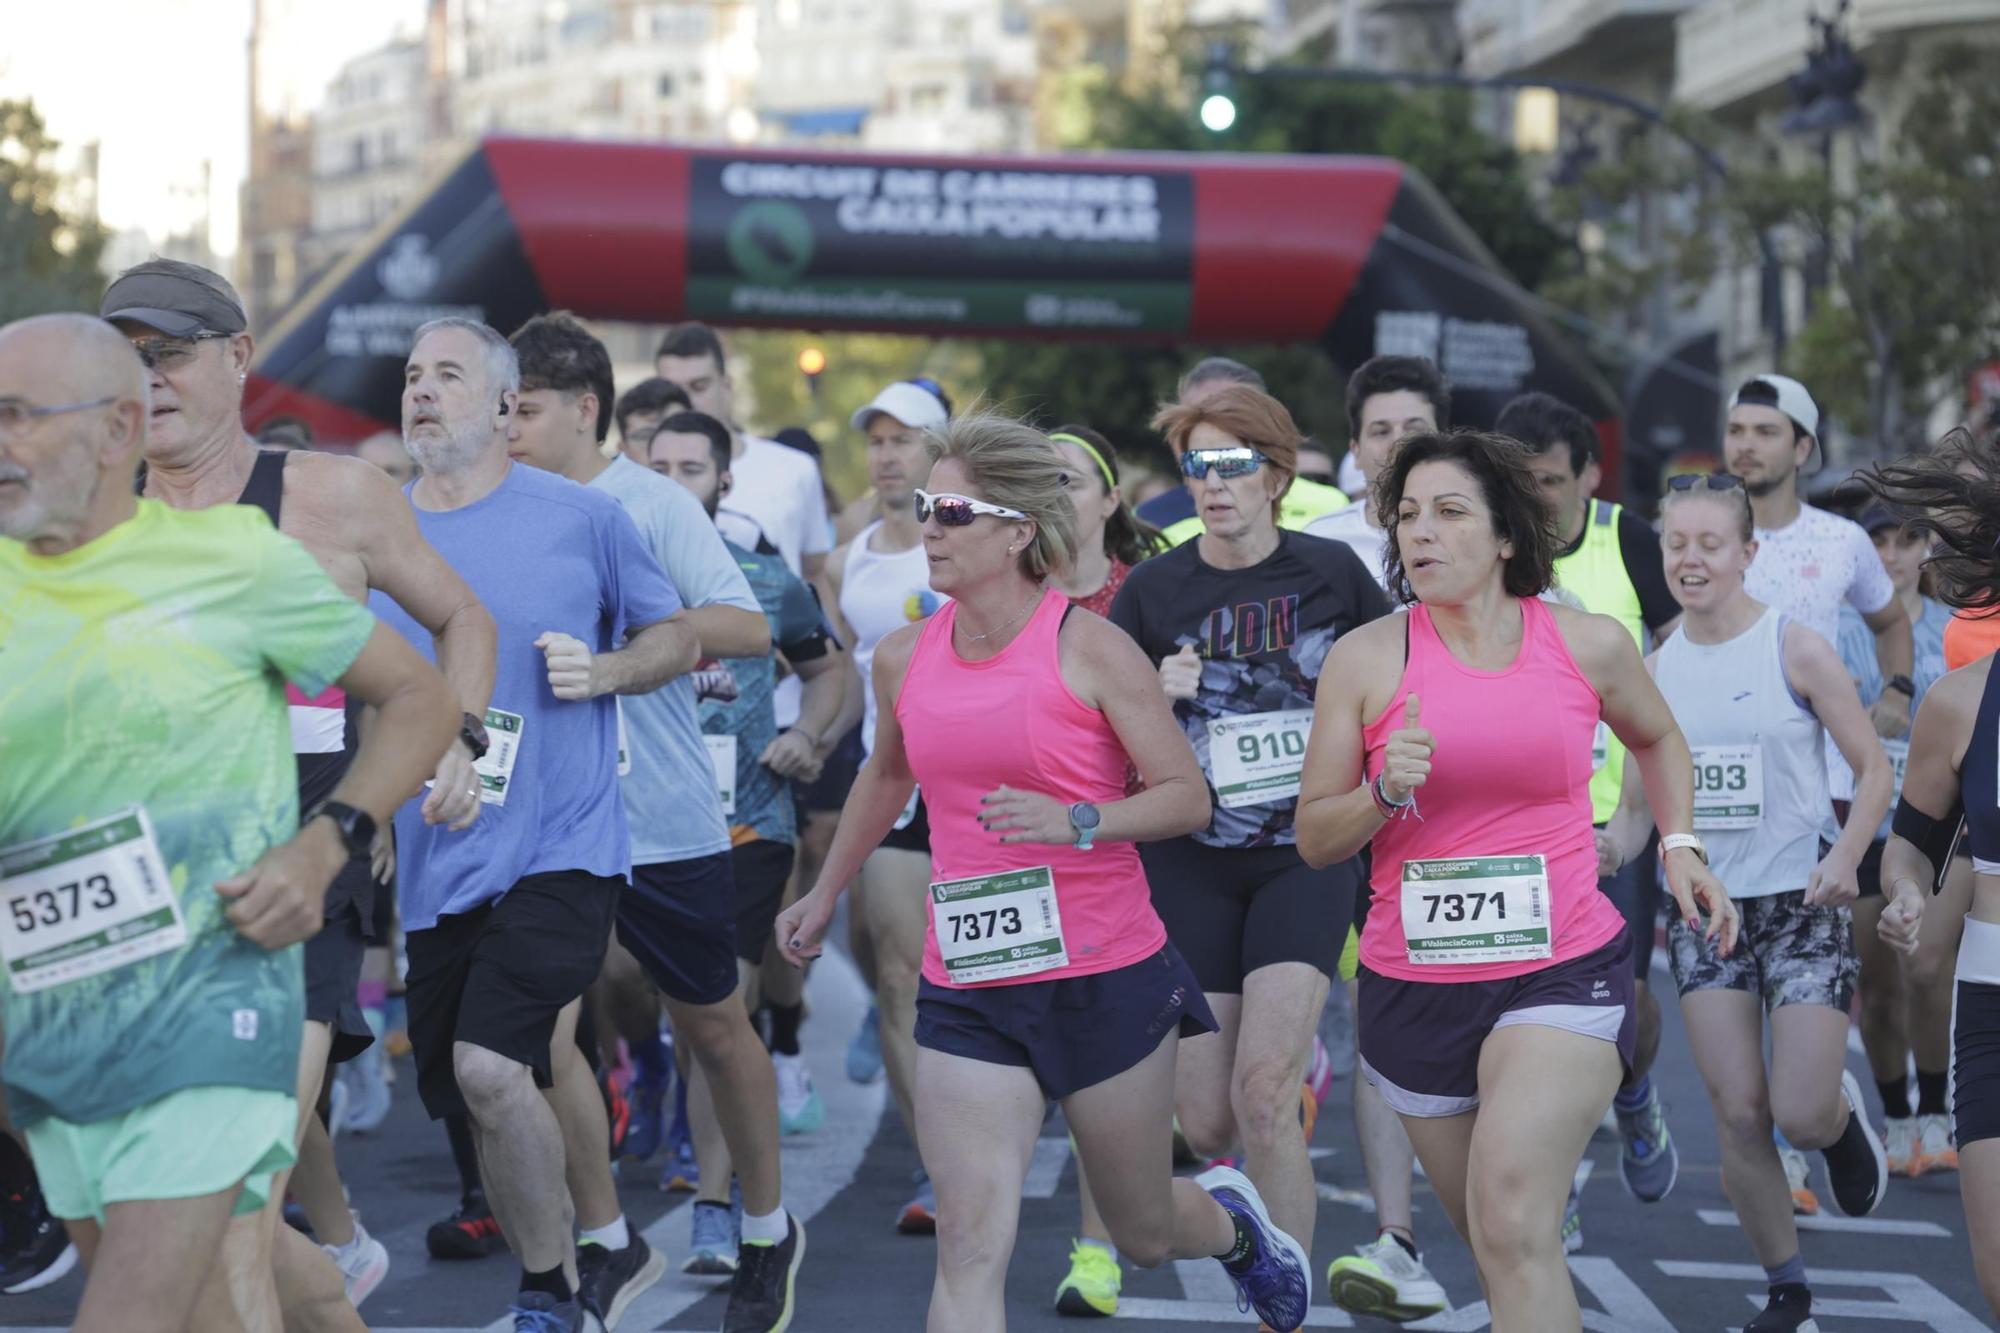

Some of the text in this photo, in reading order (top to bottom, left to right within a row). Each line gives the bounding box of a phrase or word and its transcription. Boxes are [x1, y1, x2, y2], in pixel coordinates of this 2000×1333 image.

[720, 161, 1158, 208] CIRCUIT DE CARRERES
[836, 198, 1161, 242] CAIXA POPULAR
[1206, 593, 1300, 658] LDN
[1237, 730, 1305, 763] 910
[9, 873, 117, 933] 5373
[1422, 891, 1506, 923] 7371
[947, 906, 1022, 943] 7373
[1421, 938, 1485, 948] #ValènciaCorre
